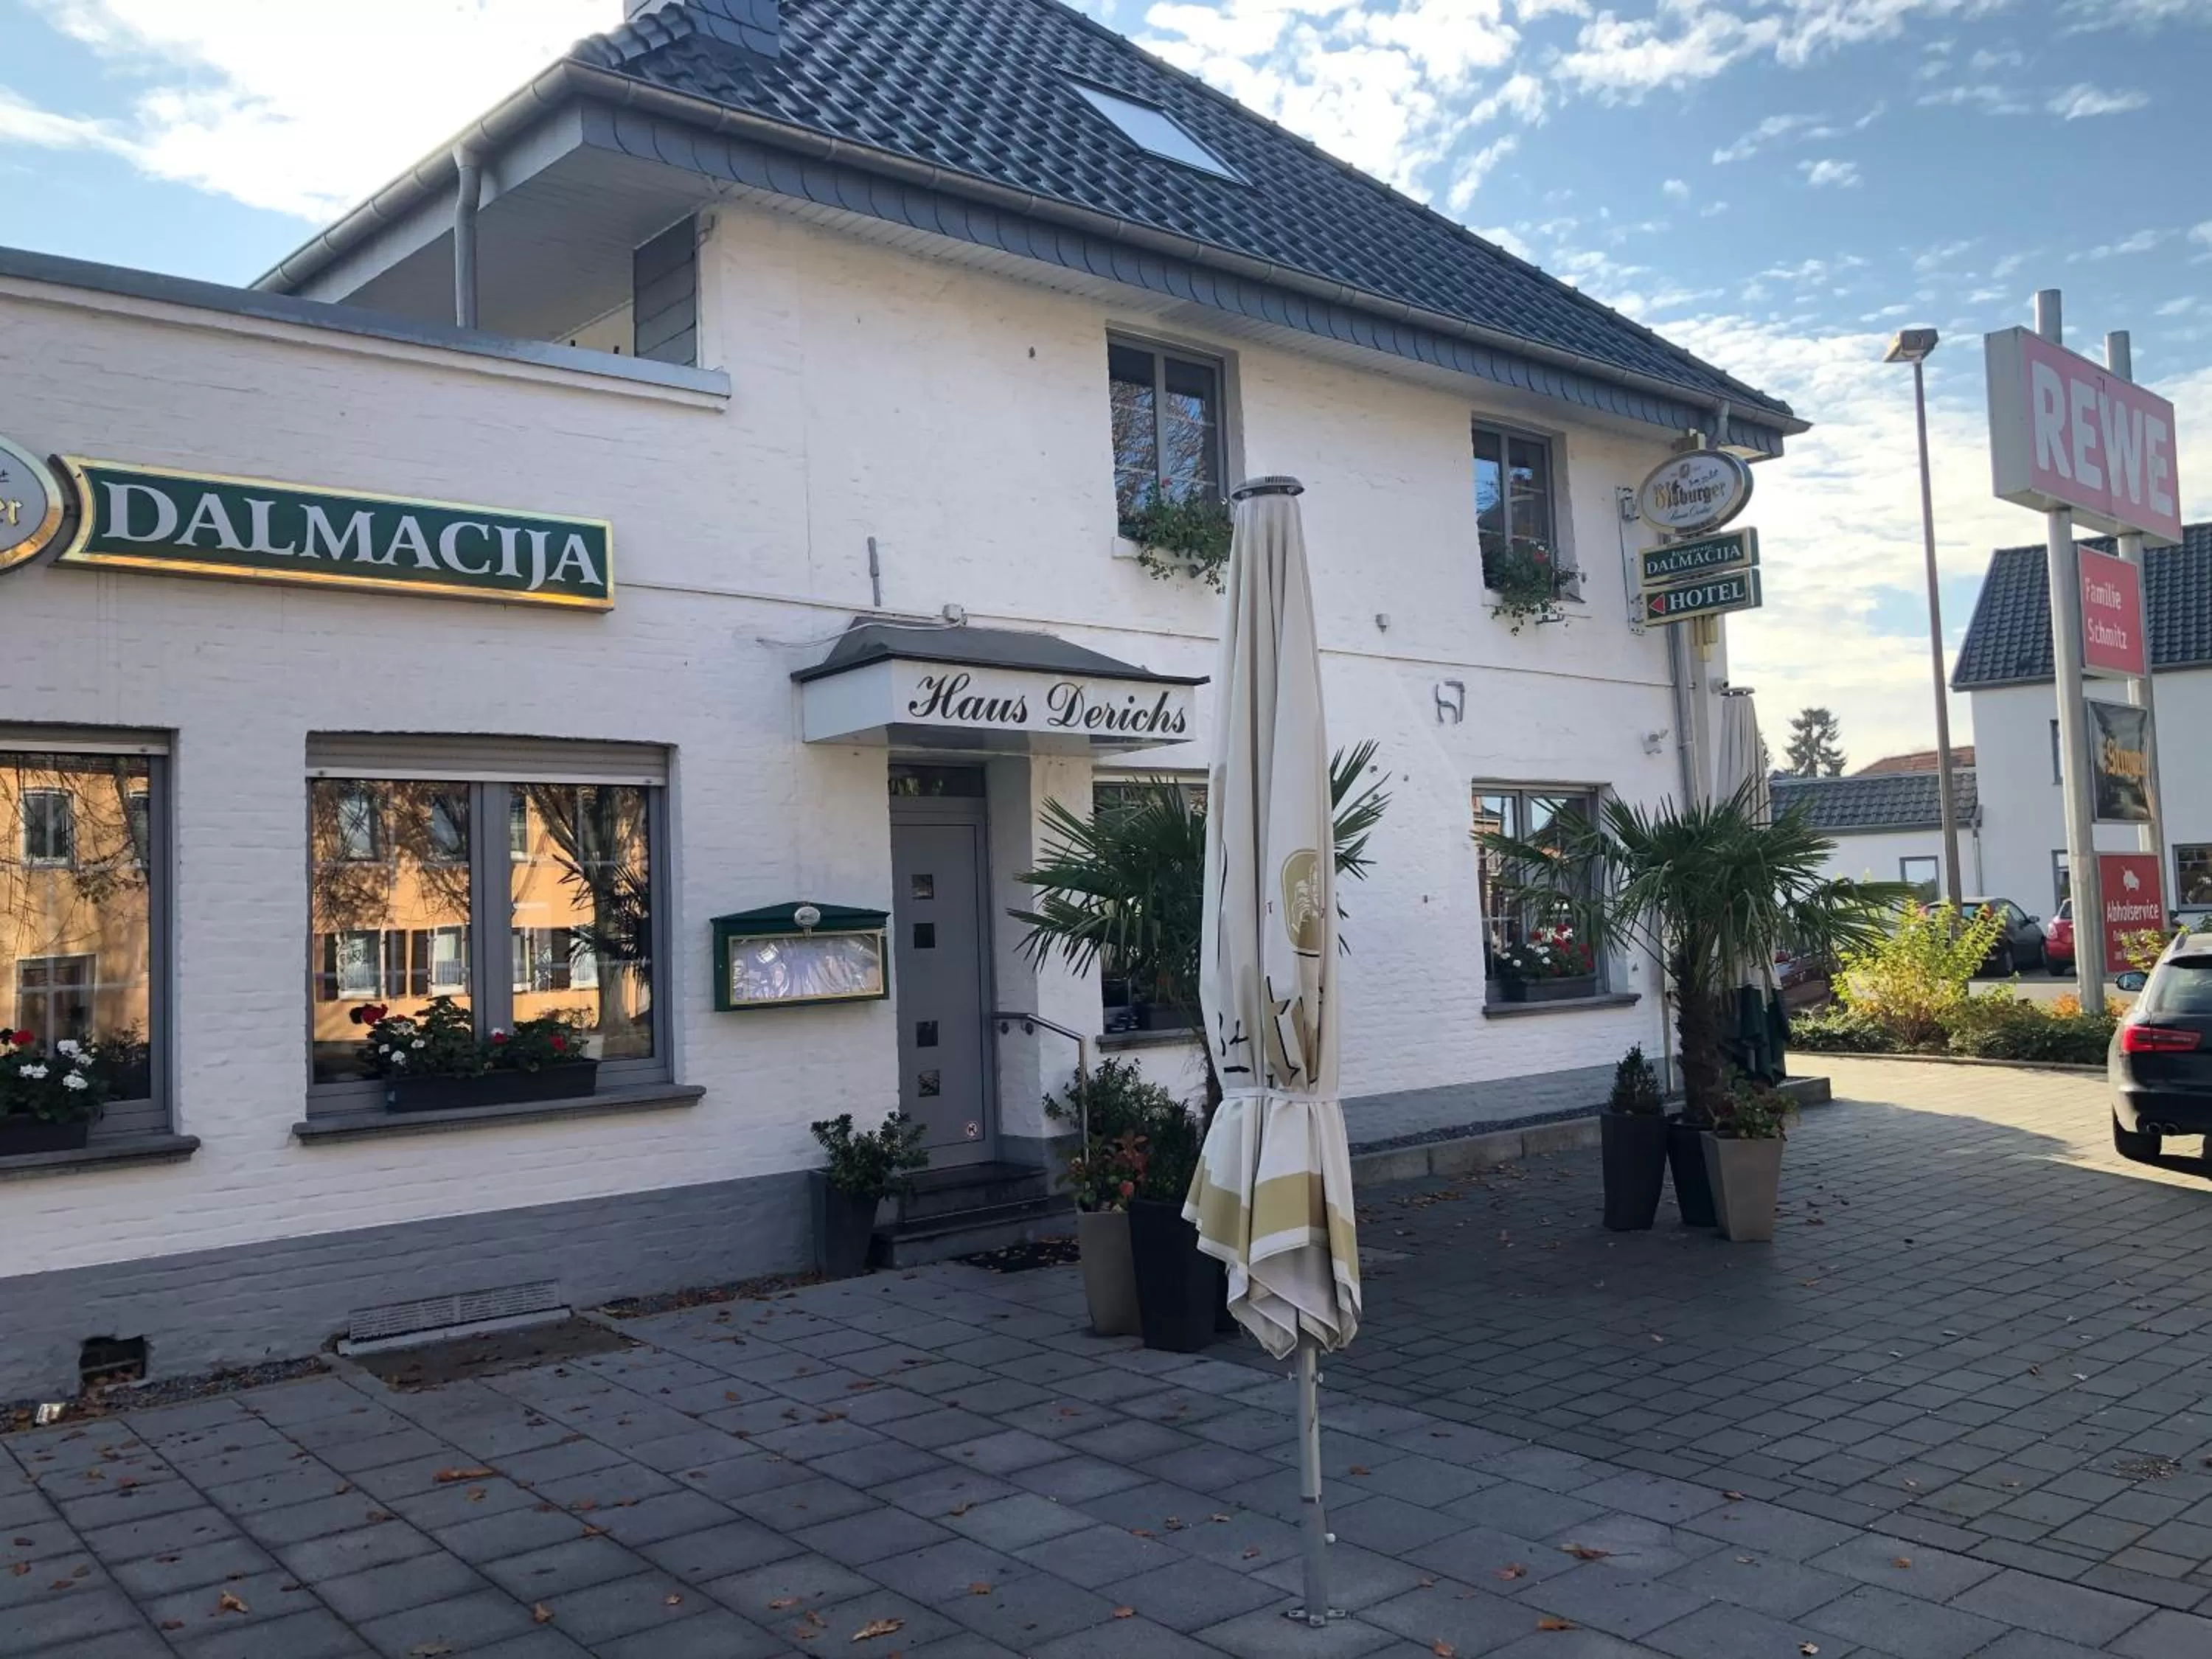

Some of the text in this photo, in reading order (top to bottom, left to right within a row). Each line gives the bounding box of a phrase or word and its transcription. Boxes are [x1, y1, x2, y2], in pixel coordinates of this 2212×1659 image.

[2031, 360, 2174, 517] REWE
[1654, 479, 1726, 509] Bitburger
[101, 480, 604, 591] DALMACIJA
[1646, 545, 1740, 574] DALMACIJA
[1669, 582, 1745, 611] HOTEL
[2085, 577, 2121, 611] Familie
[2088, 617, 2127, 650] Schmitz
[908, 672, 1186, 734] Haus Derichs
[2107, 899, 2160, 923] Abholservice
